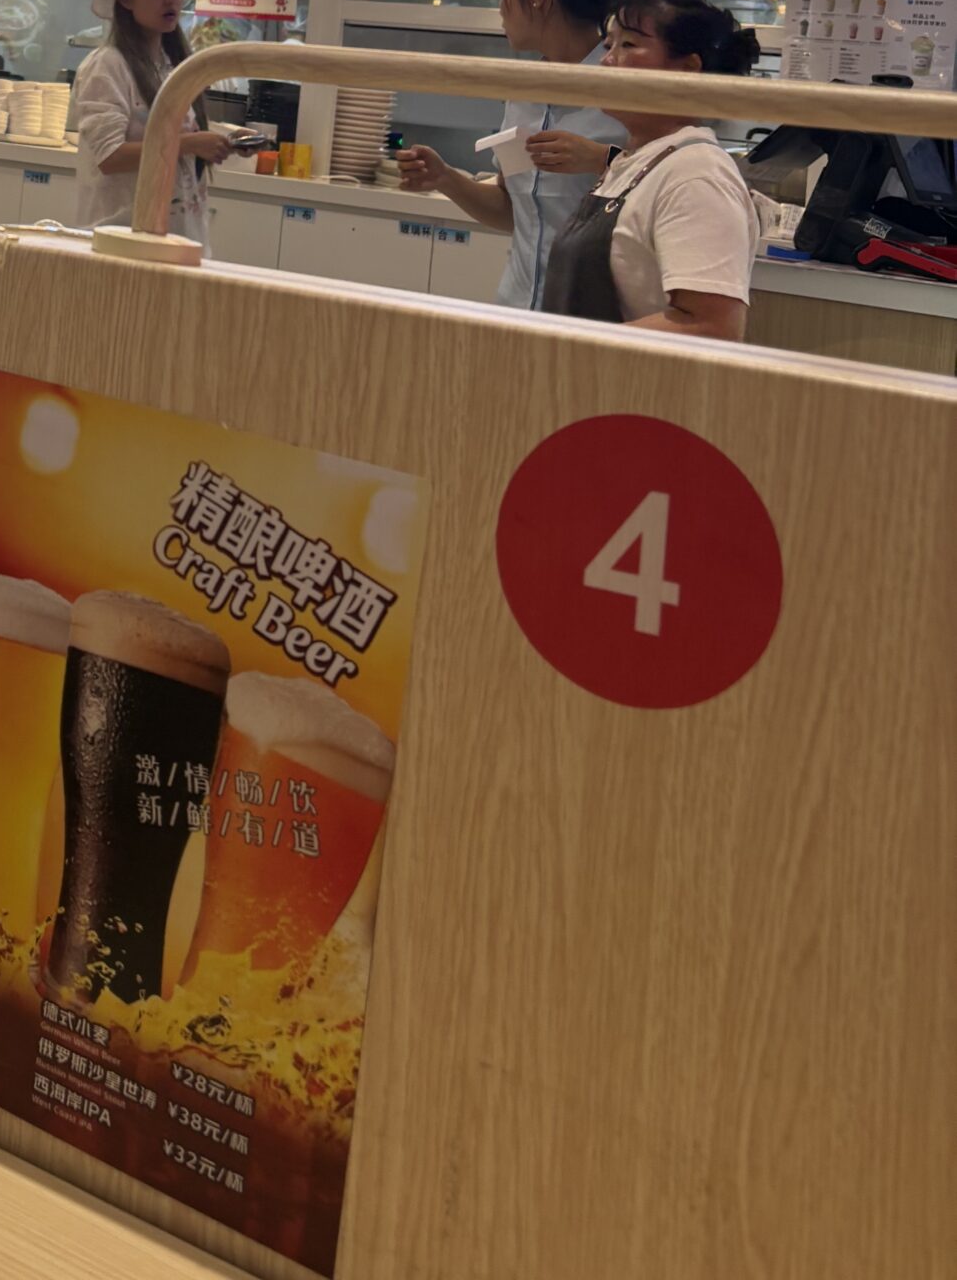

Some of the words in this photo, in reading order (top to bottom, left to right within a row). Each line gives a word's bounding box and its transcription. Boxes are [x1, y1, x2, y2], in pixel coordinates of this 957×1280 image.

[400, 222, 431, 237] 玻璃杯
[170, 461, 397, 652] 精酿啤酒
[583, 490, 680, 637] 4
[154, 525, 255, 619] Craft
[253, 593, 357, 686] Beer
[43, 1000, 109, 1046] 德式小麦
[34, 1072, 111, 1127] 西海岸IPA
[39, 1037, 157, 1109] 俄罗斯沙皇世涛
